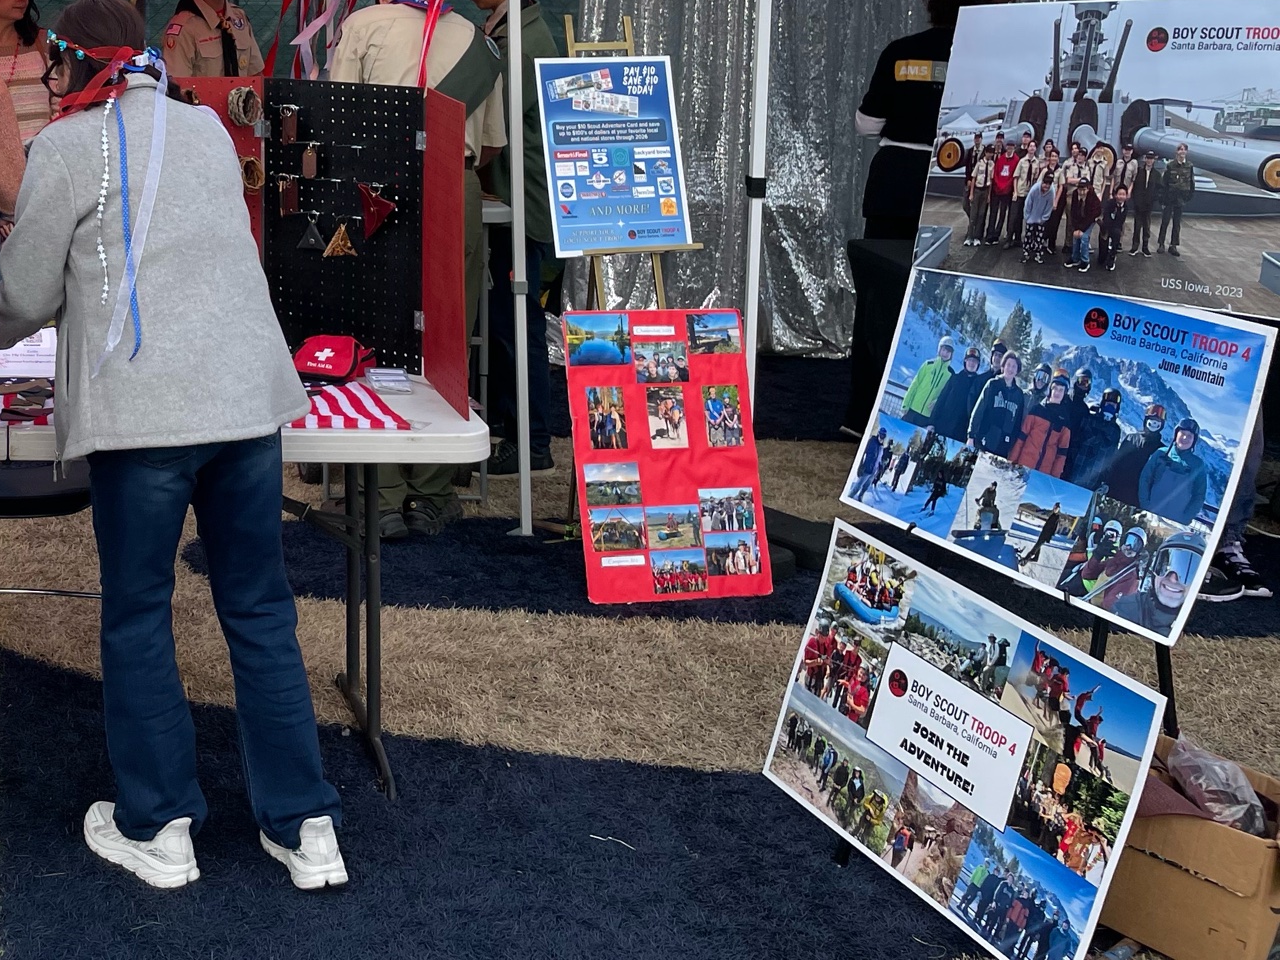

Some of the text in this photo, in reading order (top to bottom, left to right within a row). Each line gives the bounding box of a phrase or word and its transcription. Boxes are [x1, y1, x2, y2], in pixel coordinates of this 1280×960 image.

[1172, 27, 1198, 40] BOY
[1200, 27, 1243, 40] SCOUT
[1171, 41, 1280, 51] Santa Barbara, California
[622, 75, 659, 86] SAVE $10
[623, 65, 655, 77] PAY $10
[899, 66, 928, 76] AMS
[627, 85, 653, 96] TODAY
[590, 205, 612, 216] AND
[1161, 277, 1243, 298] USS Iowa, 2023
[1113, 313, 1252, 362] BOY SCOUT TROOP 4
[1110, 329, 1228, 371] Santa Barbara, California
[1158, 358, 1225, 387] June Mountain
[907, 694, 998, 760] Santa Barbara, California
[910, 679, 1018, 757] BOY SCOUT TROOP 4
[912, 720, 970, 767] JOIN THE
[899, 737, 976, 797] ADVENTURE!
